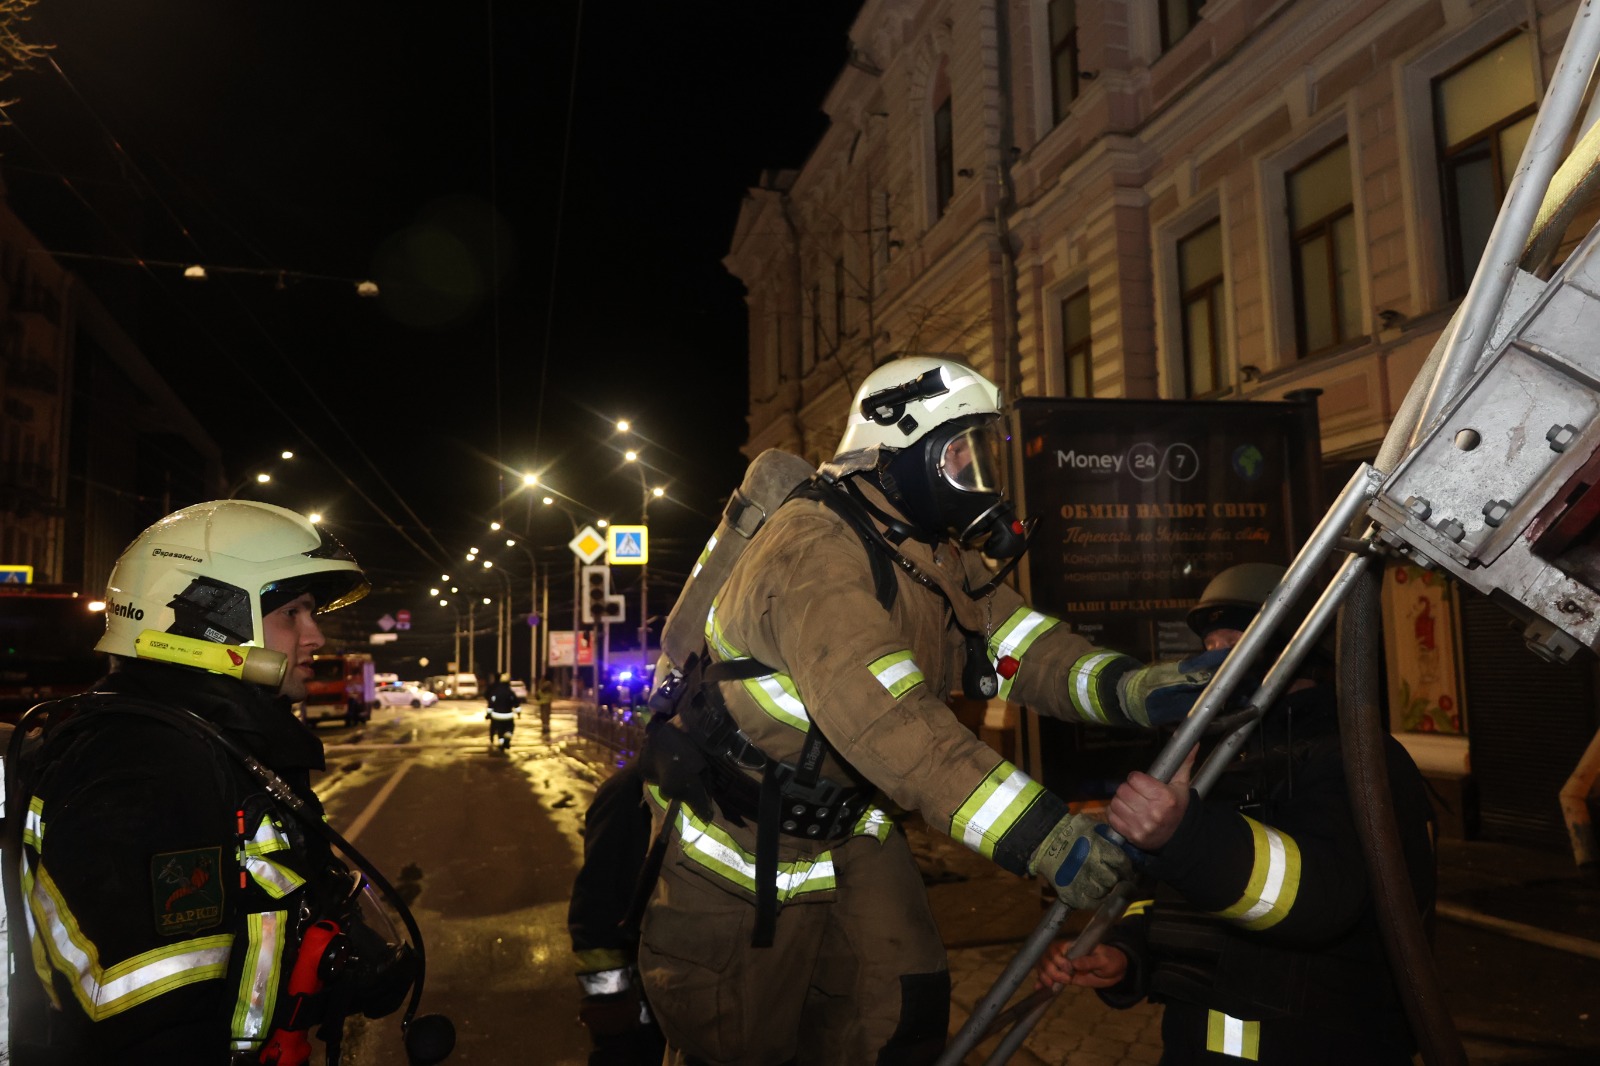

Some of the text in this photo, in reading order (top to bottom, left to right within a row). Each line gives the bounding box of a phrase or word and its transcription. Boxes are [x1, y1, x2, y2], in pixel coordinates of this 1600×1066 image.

[1057, 449, 1124, 473] Money
[1134, 454, 1156, 468] 24
[1176, 454, 1186, 468] 7
[1060, 502, 1269, 520] ОБМІН ВАЛЮТ СВІТУ
[1062, 526, 1131, 547] Перекази
[1135, 532, 1153, 543] по
[107, 597, 145, 621] chenko
[1067, 599, 1195, 612] НАШІ ПРЕДСТАВНИ
[206, 629, 226, 642] MSA
[804, 739, 822, 771] Dräger
